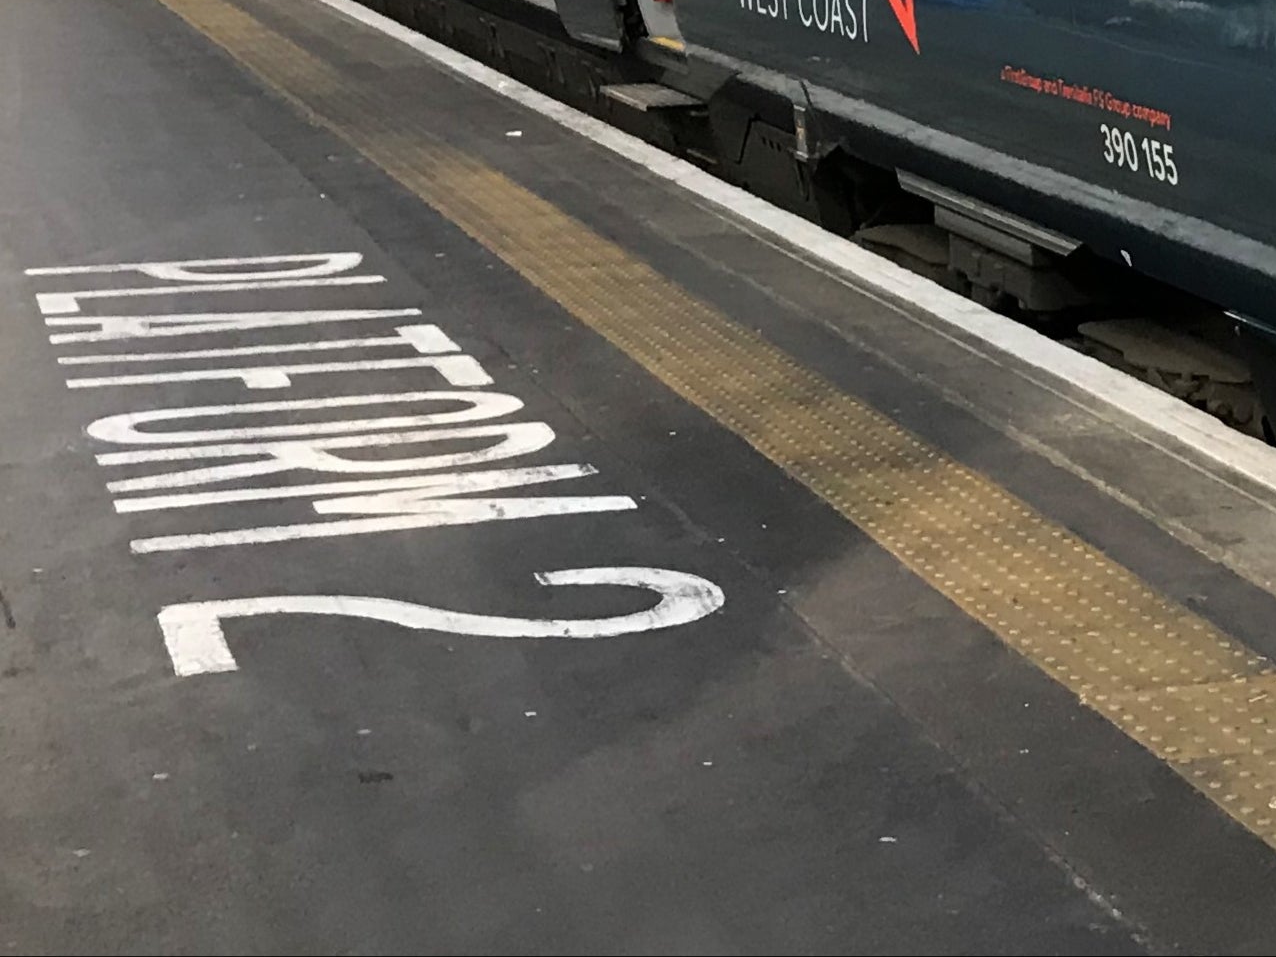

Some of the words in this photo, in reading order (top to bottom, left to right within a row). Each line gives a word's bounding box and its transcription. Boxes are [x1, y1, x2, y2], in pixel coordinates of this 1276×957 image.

[1100, 123, 1138, 172] 390
[1141, 137, 1178, 186] 155
[1105, 92, 1130, 118] Group
[1132, 104, 1172, 131] company
[24, 251, 638, 555] PLATFORM
[156, 565, 725, 677] 2
